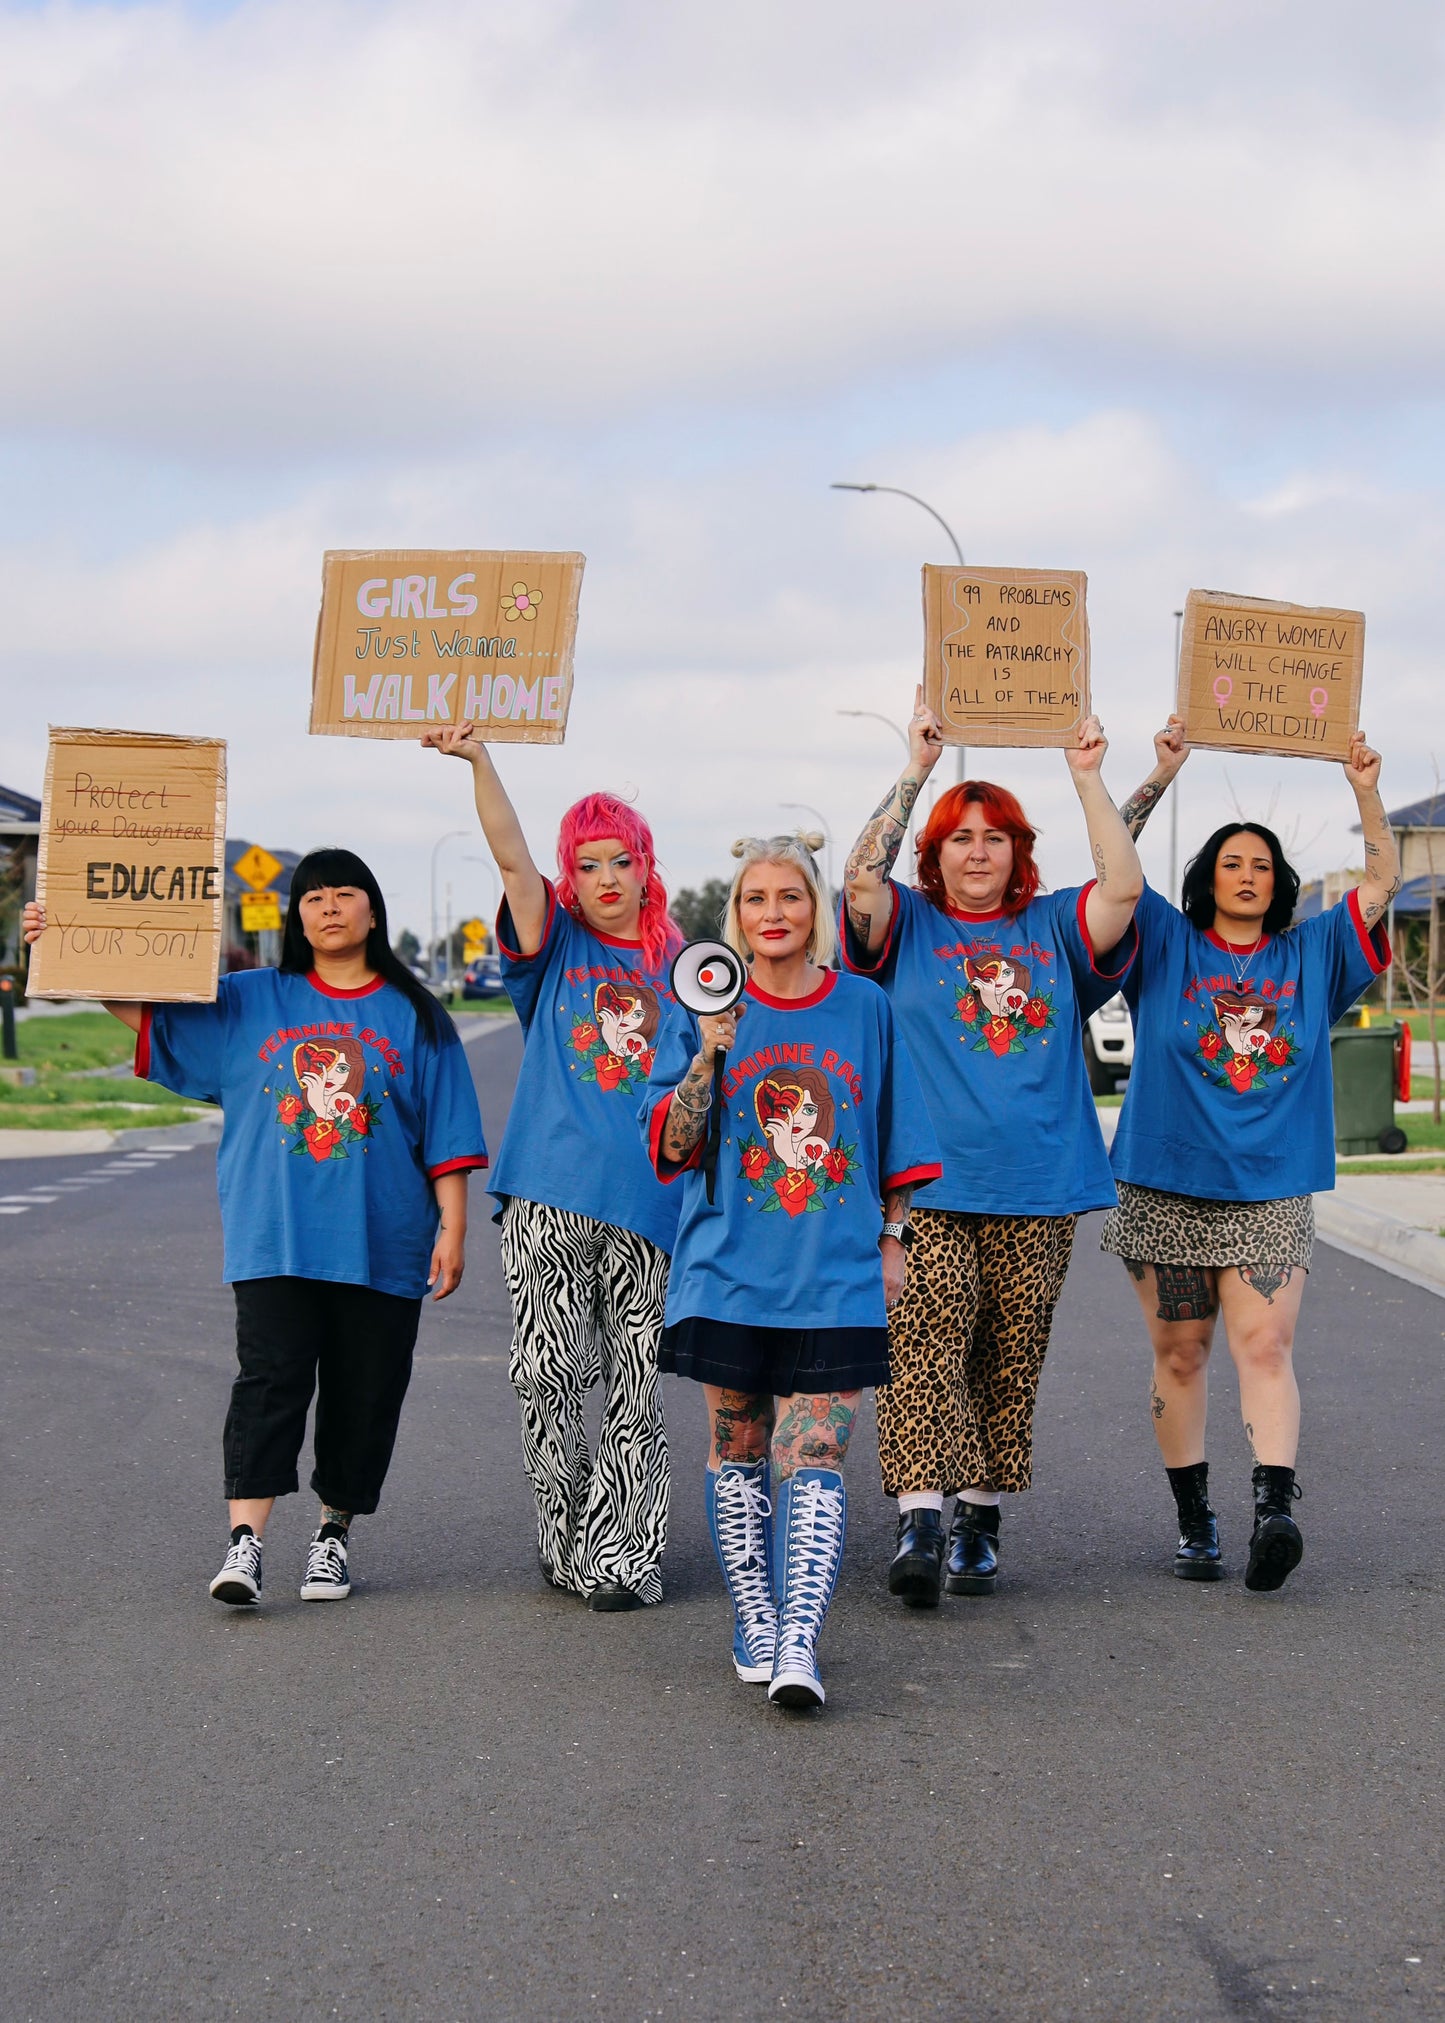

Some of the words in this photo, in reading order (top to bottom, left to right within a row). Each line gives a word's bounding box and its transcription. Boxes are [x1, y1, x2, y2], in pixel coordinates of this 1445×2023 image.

[356, 572, 479, 619] GIRLS
[962, 585, 981, 605] 99
[999, 585, 1072, 607] PROBLEMS
[986, 616, 1021, 632] AND
[1204, 615, 1268, 643] ANGRY
[1277, 623, 1347, 650] WOMEN
[355, 627, 421, 659] Just
[944, 643, 976, 658] THE
[986, 643, 1074, 664] PATRIARCHY
[993, 667, 1011, 681] IS
[1214, 651, 1257, 672] WILL
[1268, 655, 1343, 681] CHANGE
[343, 673, 457, 720] WALK
[463, 674, 567, 721] HOME
[949, 687, 984, 705] ALL
[995, 690, 1014, 702] OF
[1024, 690, 1079, 707] THEM!
[1242, 681, 1288, 704] THE
[1217, 708, 1328, 742] WORLD!!!
[86, 862, 220, 901] EDUCATE
[54, 913, 124, 960] YOUR
[257, 1020, 357, 1063] FEMININE
[358, 1027, 406, 1078] RAGE
[720, 1043, 815, 1108] EMININE
